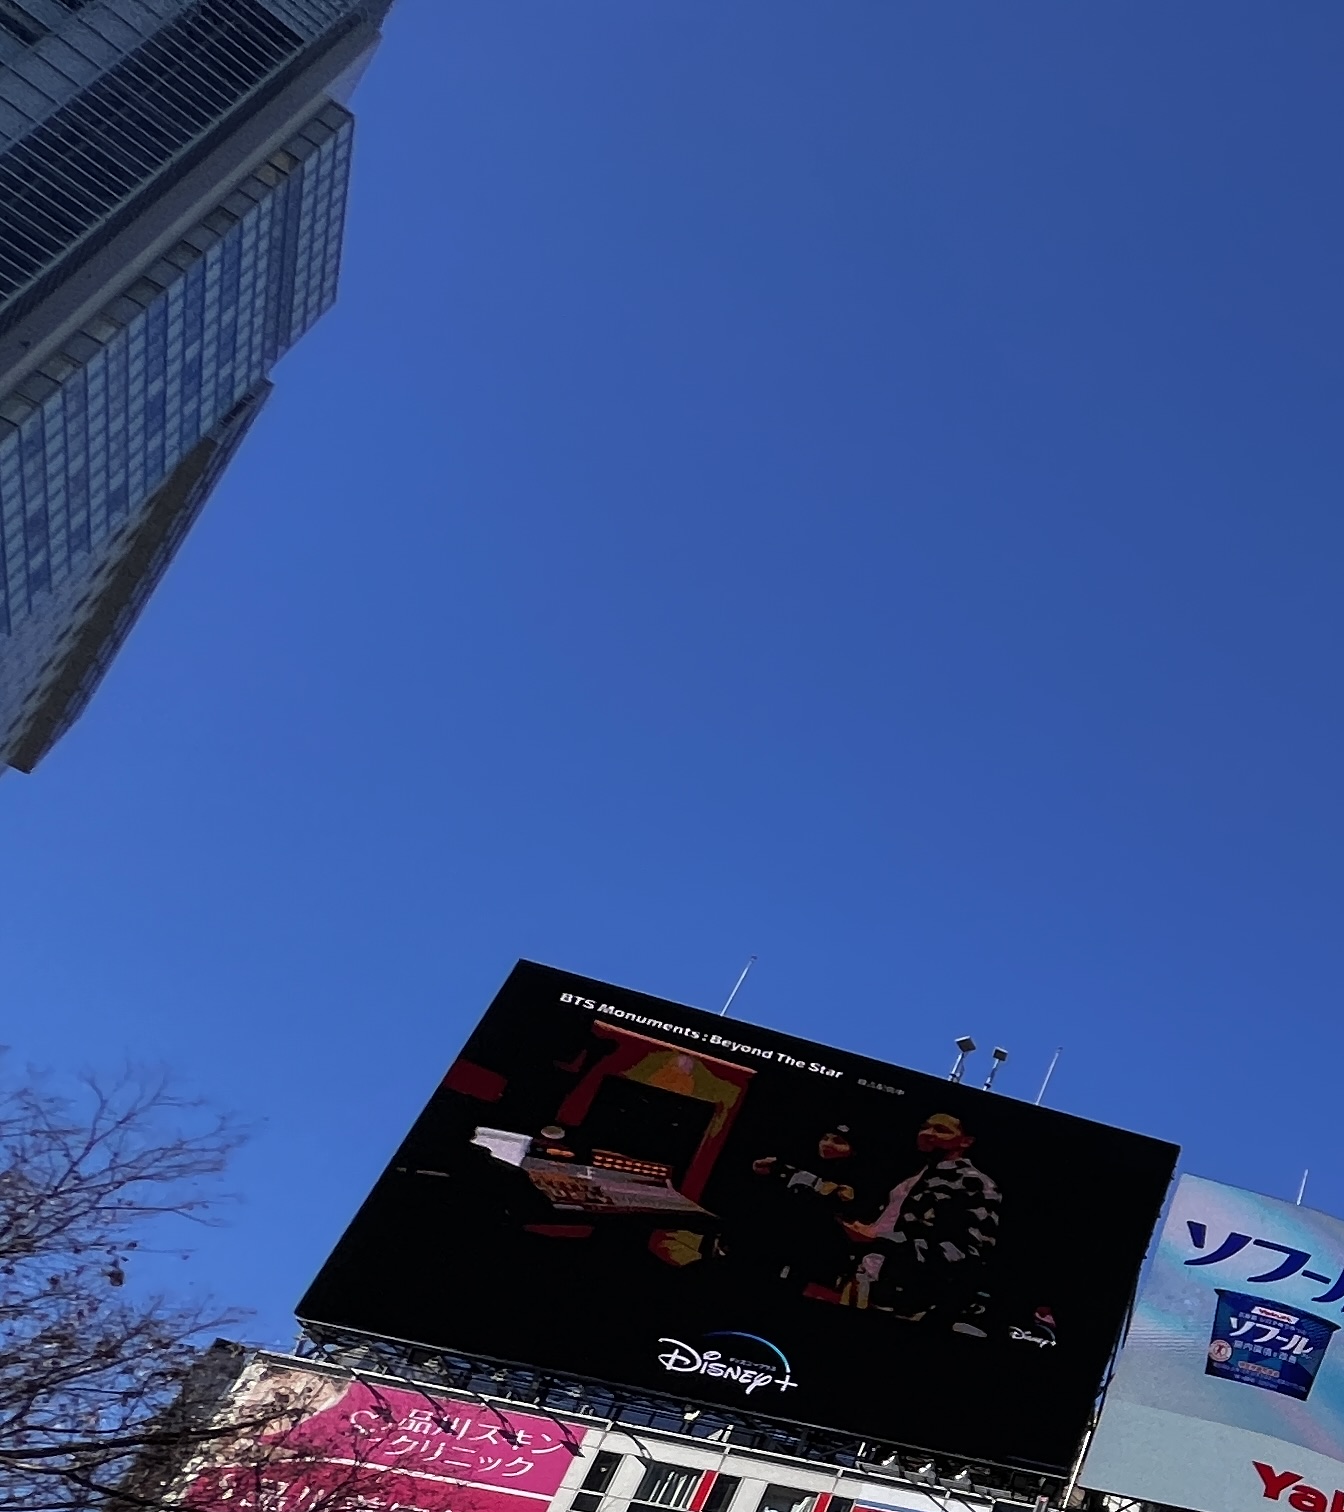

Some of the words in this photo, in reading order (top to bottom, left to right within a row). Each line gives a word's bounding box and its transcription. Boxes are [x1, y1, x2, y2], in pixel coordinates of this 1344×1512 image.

[560, 992, 597, 1011] BTS
[709, 1034, 774, 1061] Beyond
[776, 1052, 805, 1069] The
[808, 1063, 844, 1080] Star
[1229, 1316, 1315, 1356] ソフール
[384, 1436, 536, 1479] クリニック
